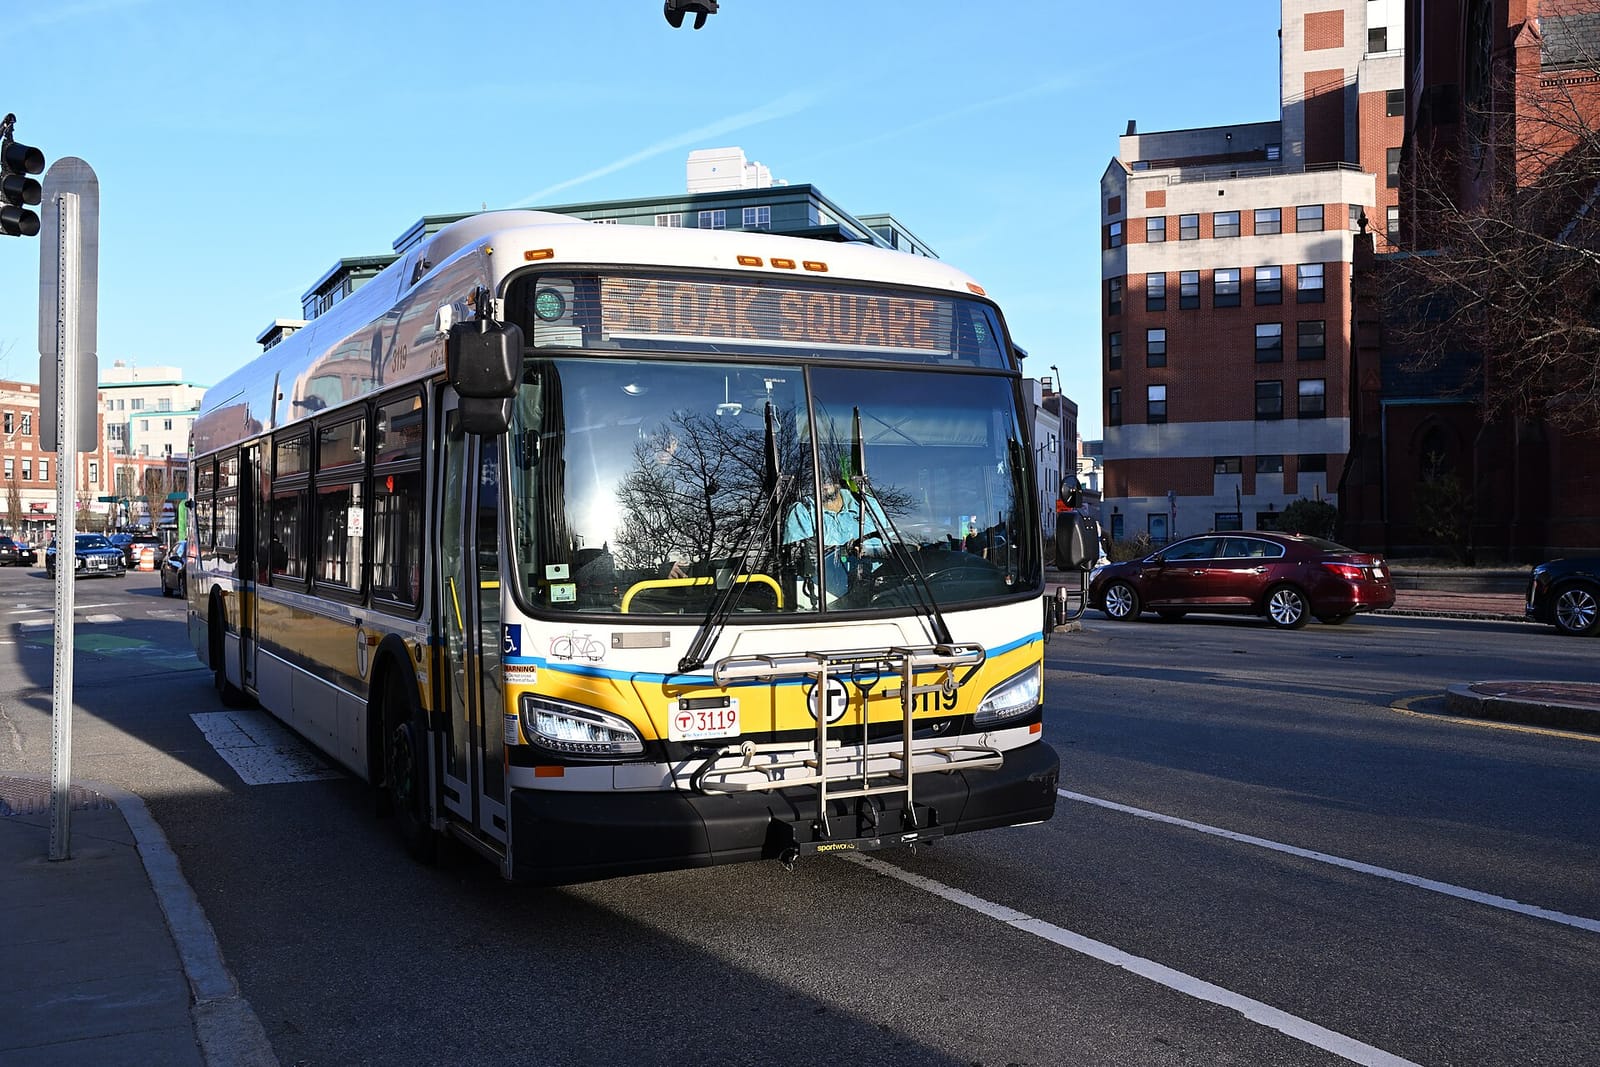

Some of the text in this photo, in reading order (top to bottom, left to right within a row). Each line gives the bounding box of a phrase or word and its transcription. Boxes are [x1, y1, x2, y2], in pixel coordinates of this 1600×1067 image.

[601, 279, 933, 350] 64 OAK SQUARE
[392, 344, 408, 373] 3119
[697, 711, 735, 731] 3119
